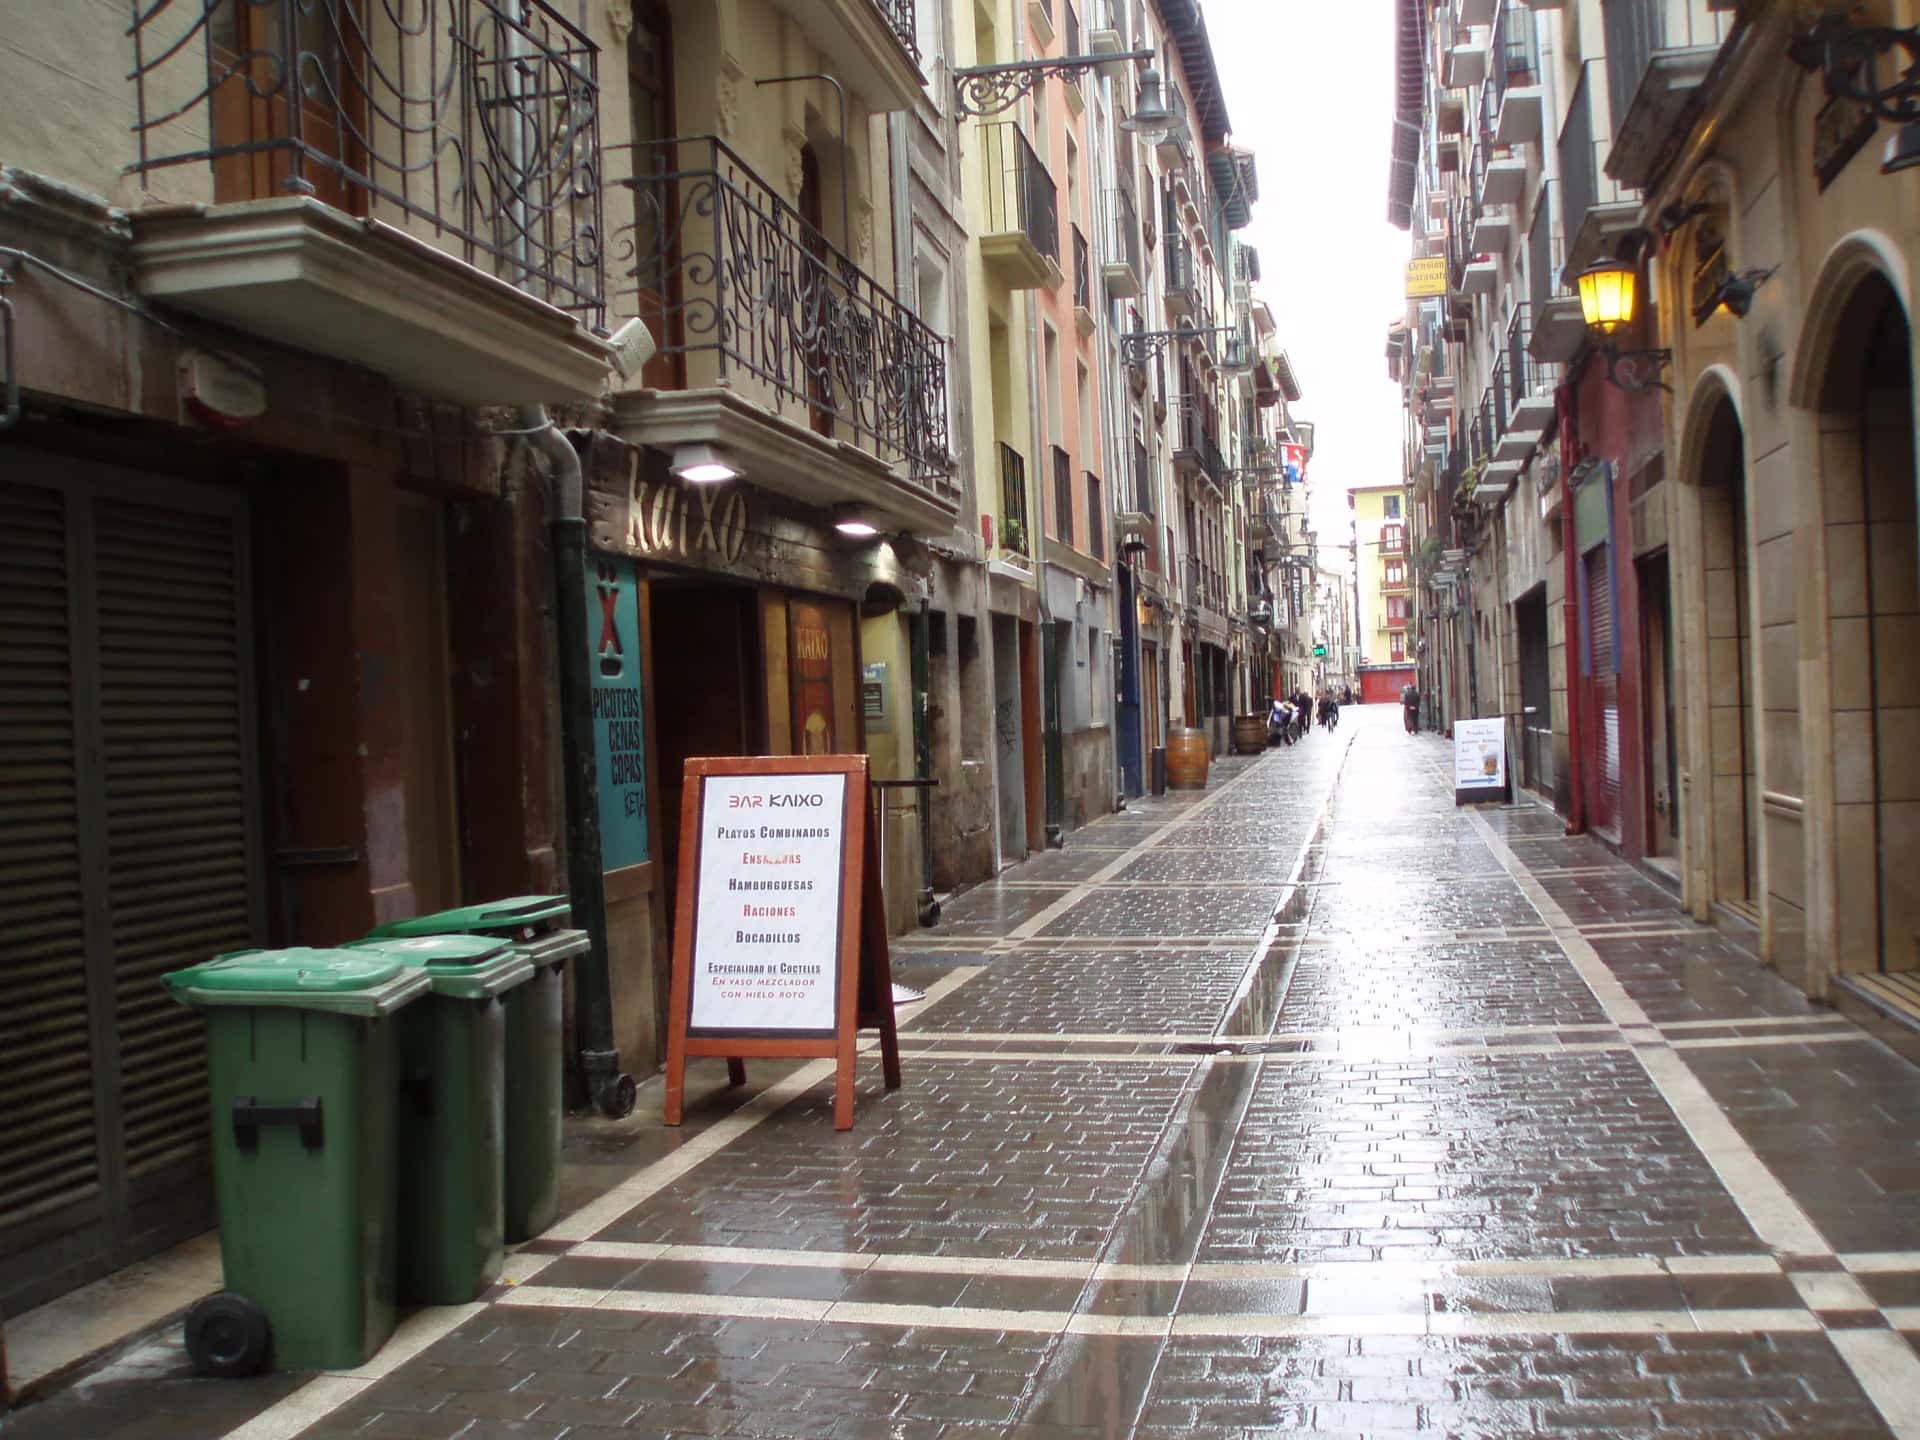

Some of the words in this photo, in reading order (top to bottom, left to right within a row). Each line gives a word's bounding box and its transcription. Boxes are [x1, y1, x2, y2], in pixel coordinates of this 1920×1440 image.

[593, 688, 640, 720] PICOTEOS
[609, 720, 640, 752] CENAS
[611, 754, 642, 785] COPAS
[729, 795, 763, 808] BAR
[769, 794, 823, 807] KAIXO
[718, 827, 756, 839] PLATOS
[760, 826, 830, 839] COMBINADOS
[729, 878, 814, 891] HAMBURGUESAS
[743, 904, 796, 917] RACIONES
[736, 930, 800, 943] BOCADILLOS
[708, 962, 765, 973] ESPECIALIDAD
[767, 964, 777, 973] DE
[780, 962, 821, 974] COCTELES
[712, 977, 725, 986] EN
[721, 991, 741, 999] CON
[746, 991, 774, 999] HIELO
[779, 991, 805, 999] ROTO
